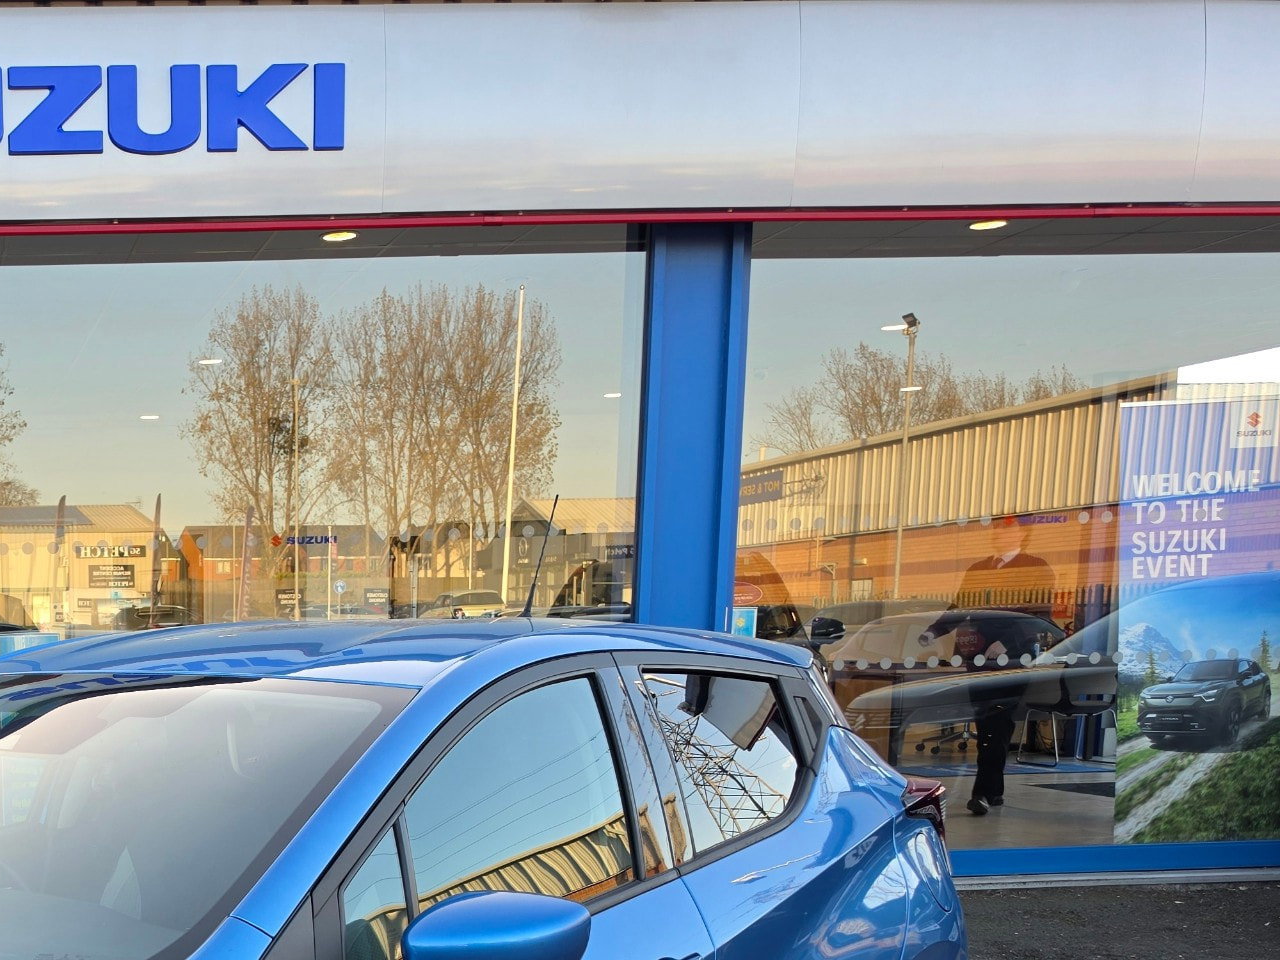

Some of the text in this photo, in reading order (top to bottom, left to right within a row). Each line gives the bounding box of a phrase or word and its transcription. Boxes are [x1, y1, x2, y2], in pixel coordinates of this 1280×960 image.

[1236, 429, 1272, 438] SUZUKI
[1132, 469, 1261, 498] WELCOME
[1132, 498, 1225, 525] TO THE
[286, 535, 338, 545] SUZUKI
[1131, 527, 1226, 555] SUZUKI
[1132, 553, 1213, 579] EVENT
